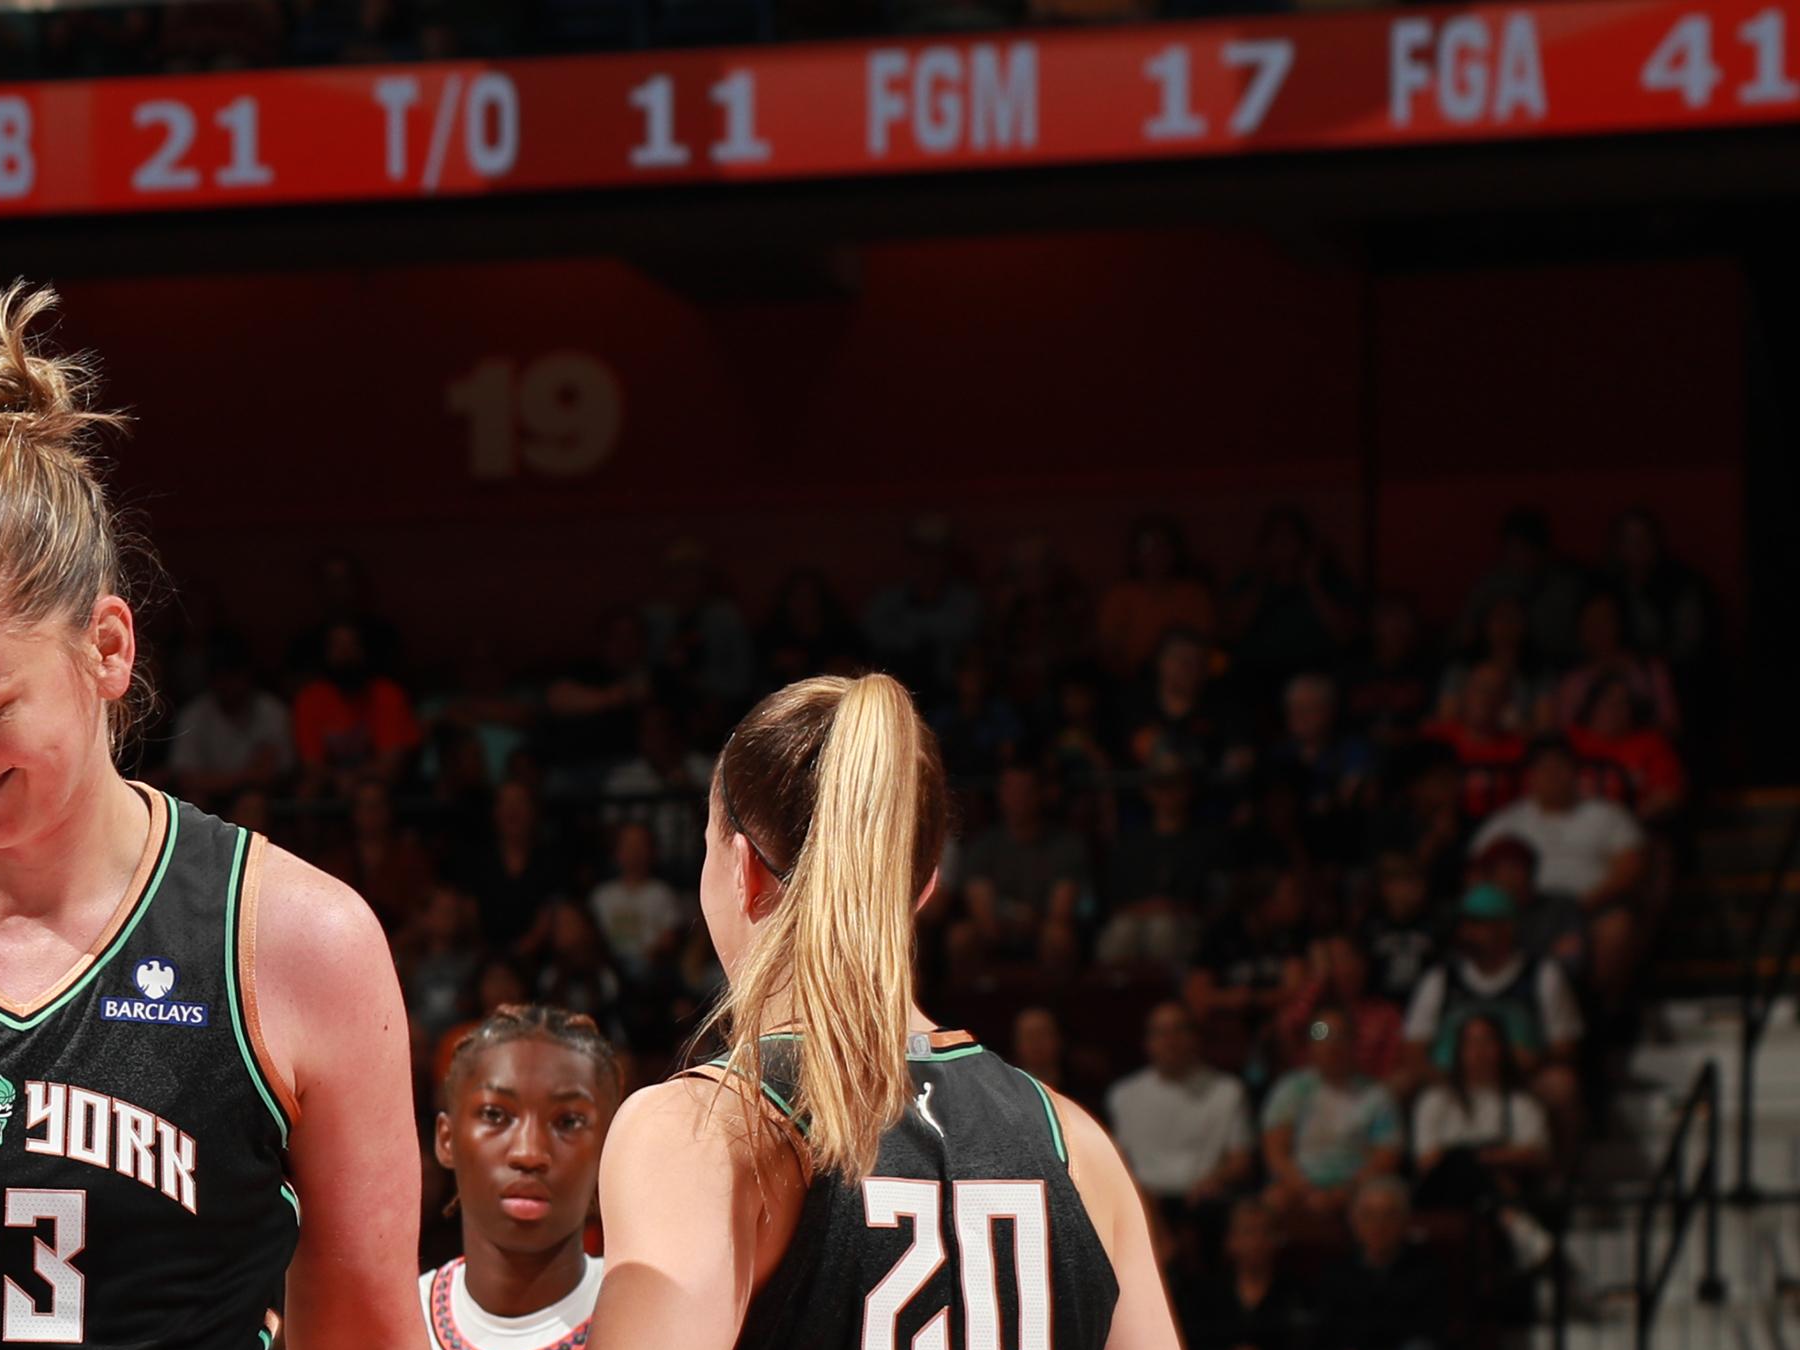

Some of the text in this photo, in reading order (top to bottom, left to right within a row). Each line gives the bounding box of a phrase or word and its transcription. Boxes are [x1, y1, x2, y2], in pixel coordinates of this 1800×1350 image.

[132, 97, 274, 190] 21
[374, 73, 518, 193] T/O
[629, 70, 771, 166] 11
[868, 44, 1037, 154] FGM
[1144, 42, 1293, 138] 17
[1391, 13, 1546, 124] FGA
[1641, 8, 1800, 107] 41
[445, 349, 627, 477] 19
[105, 998, 203, 1024] BARCLAYS
[25, 1080, 197, 1216] YORK
